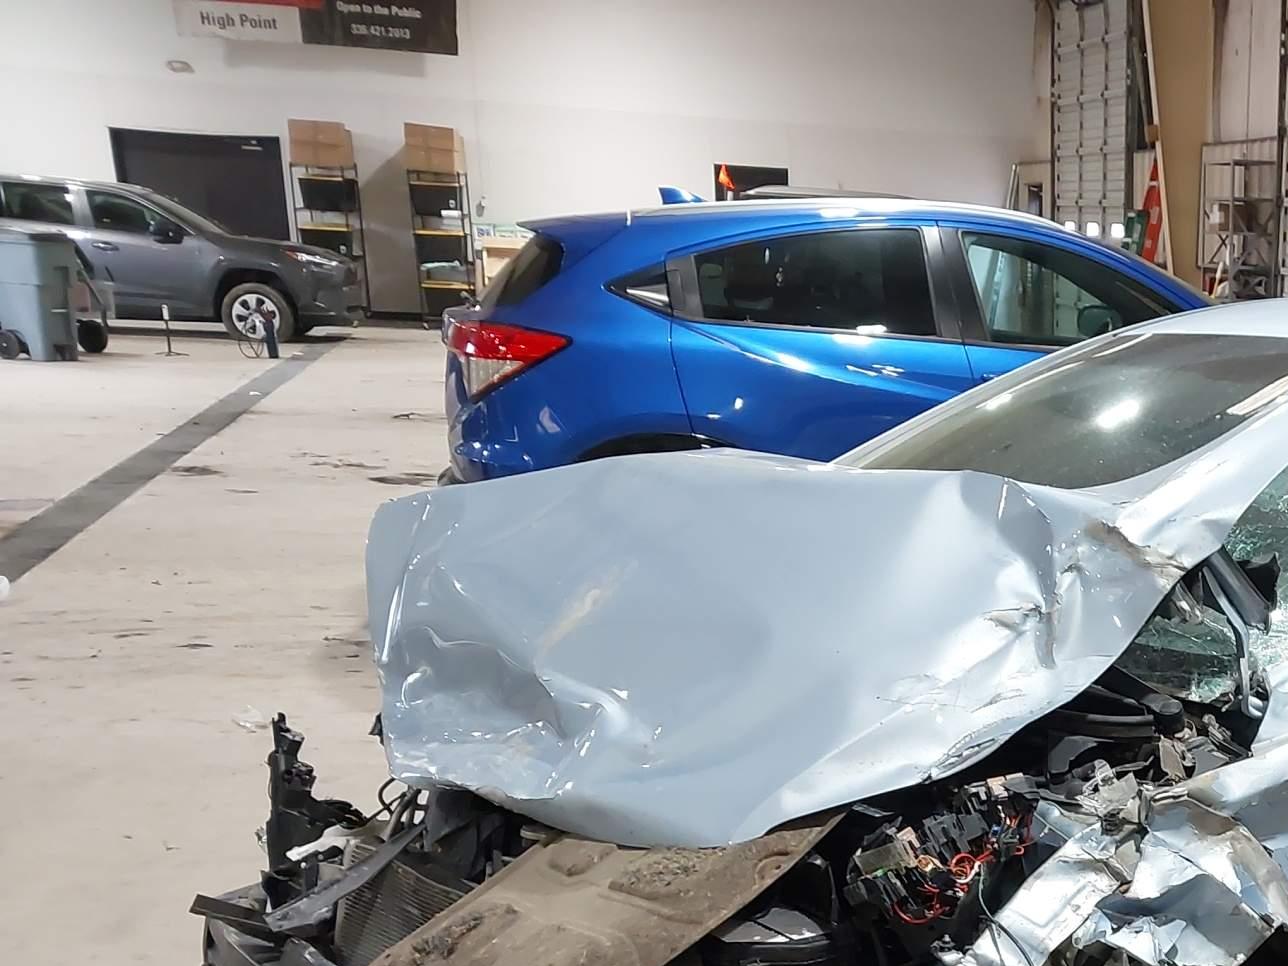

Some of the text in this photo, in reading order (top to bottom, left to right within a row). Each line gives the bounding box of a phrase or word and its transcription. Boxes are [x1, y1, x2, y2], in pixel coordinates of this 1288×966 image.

[336, 1, 423, 19] Open to the Public
[200, 11, 278, 31] High Point
